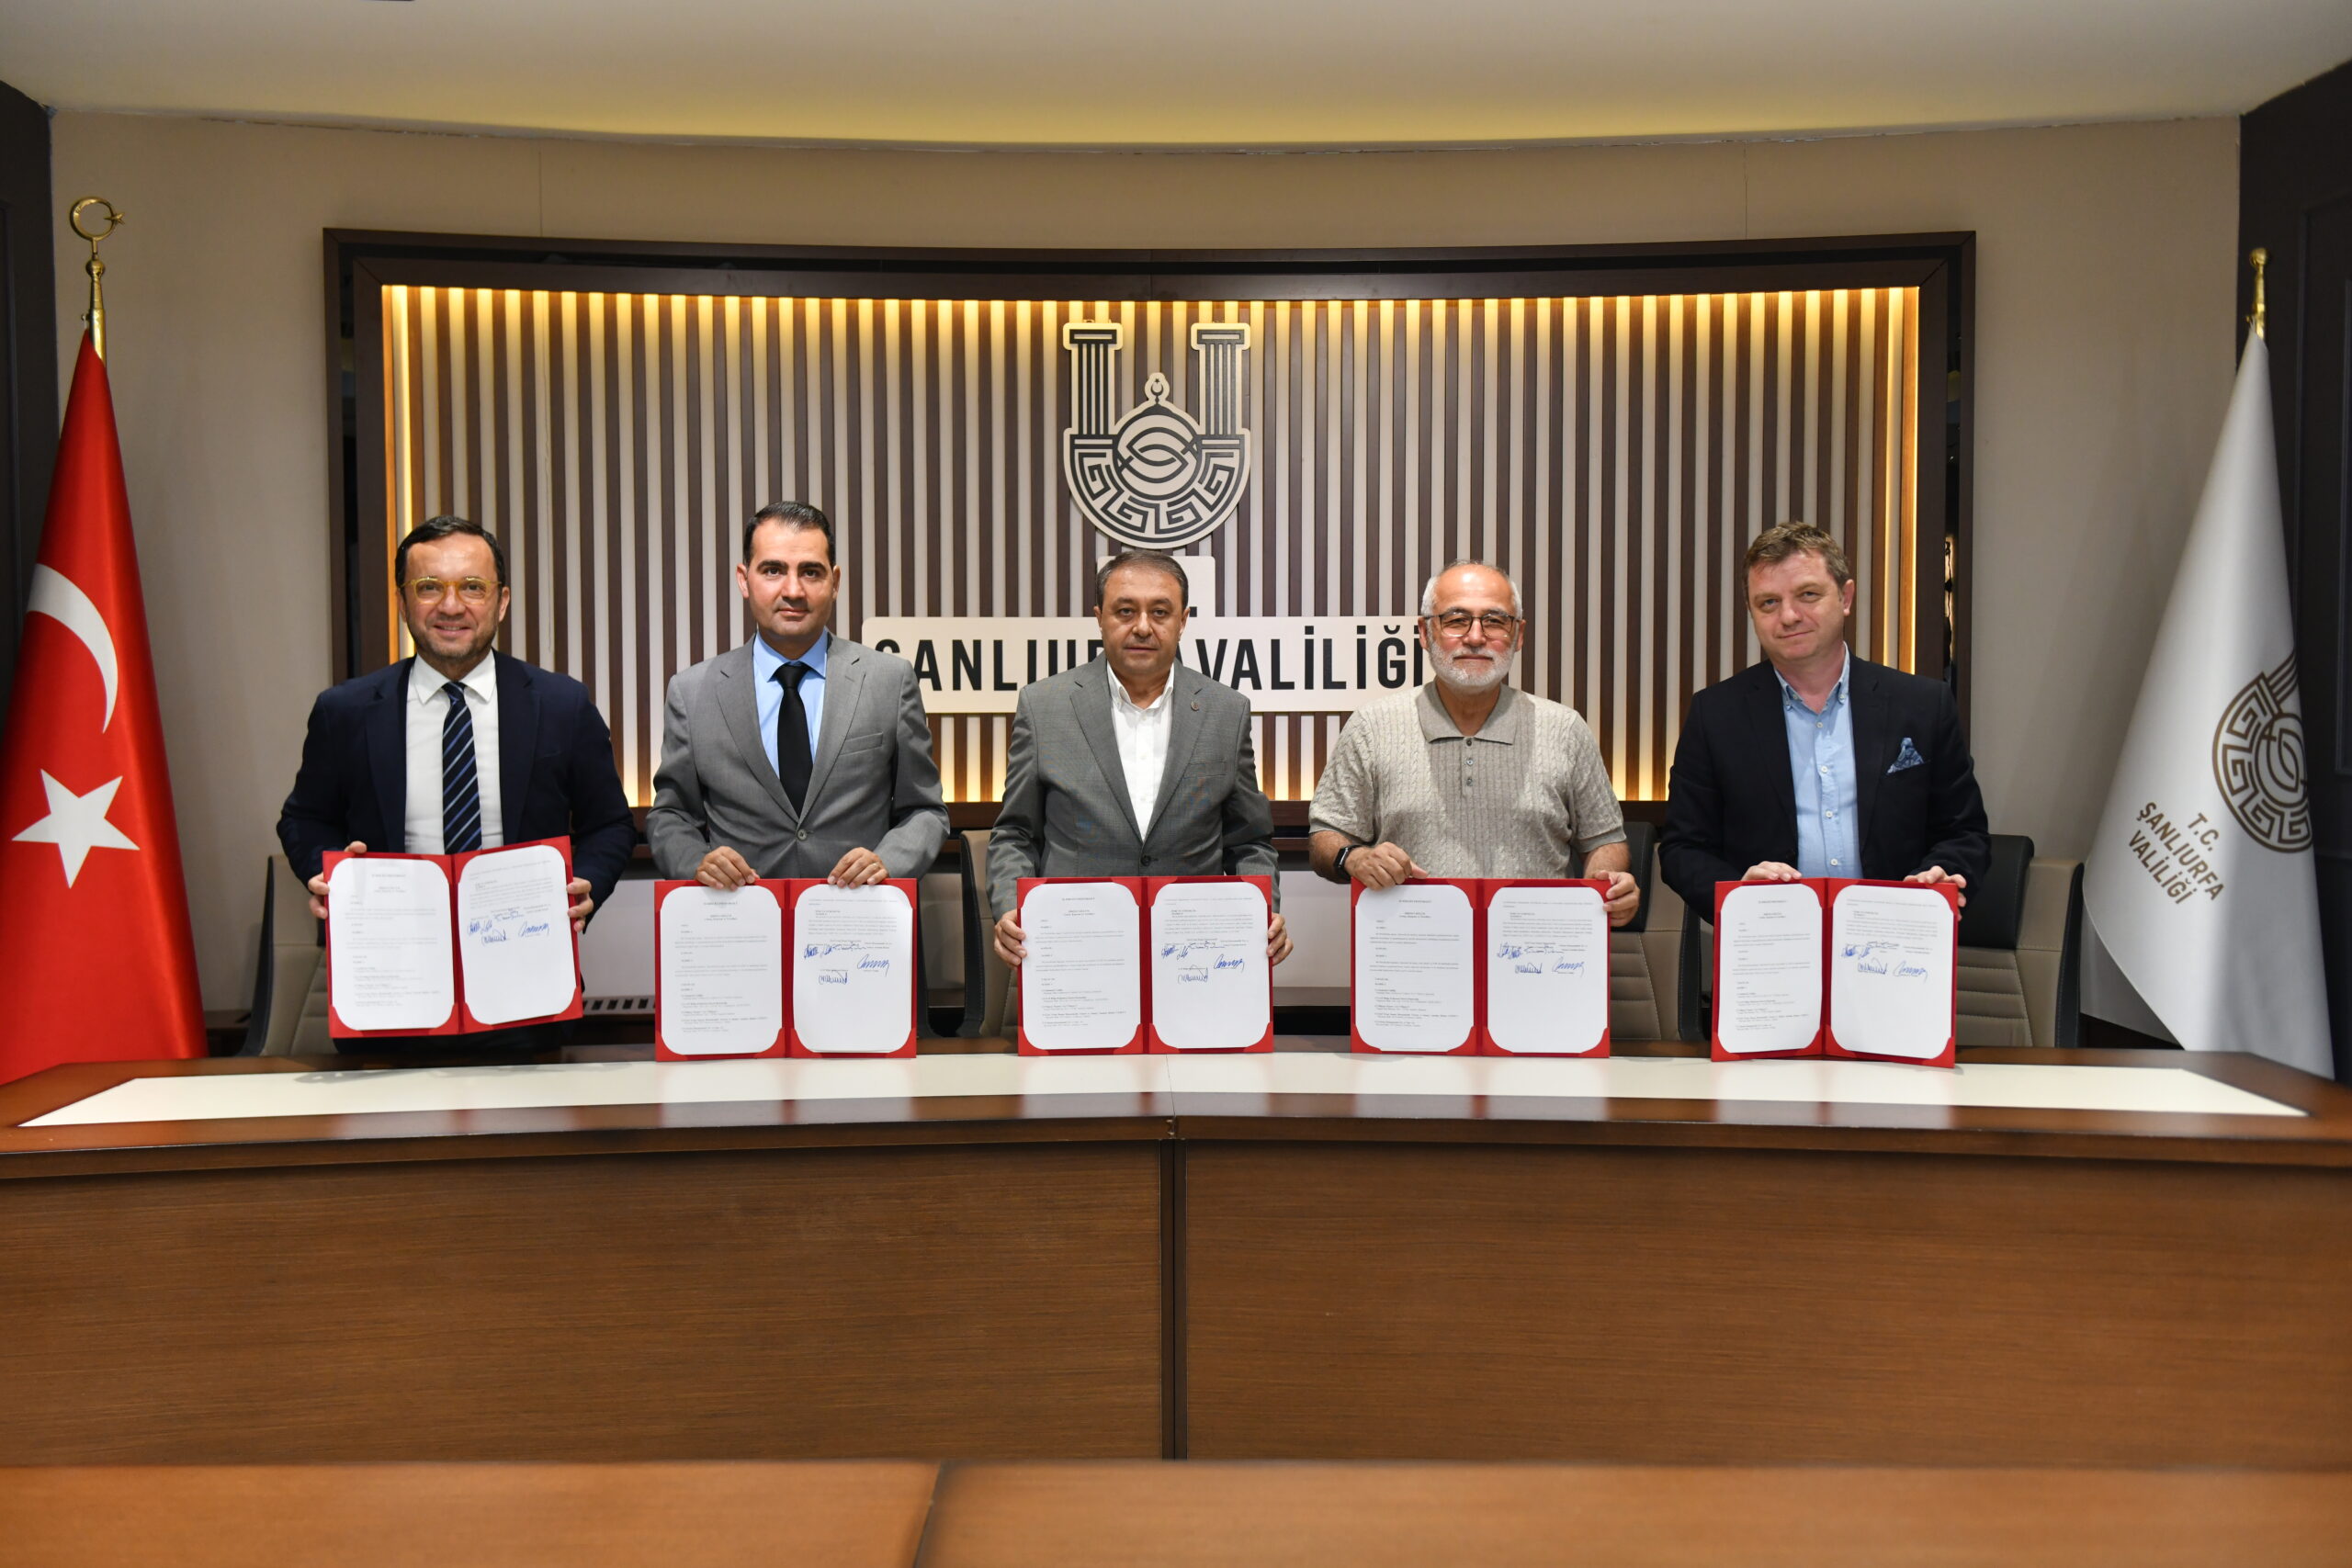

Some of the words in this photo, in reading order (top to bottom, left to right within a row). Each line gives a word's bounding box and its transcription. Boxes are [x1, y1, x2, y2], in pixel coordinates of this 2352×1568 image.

[1196, 625, 1423, 691] VALİLİĞİ
[2129, 830, 2198, 904] VALİLİĞİ
[2136, 802, 2224, 900] ŞANLIURFA
[2188, 812, 2219, 852] T.C.
